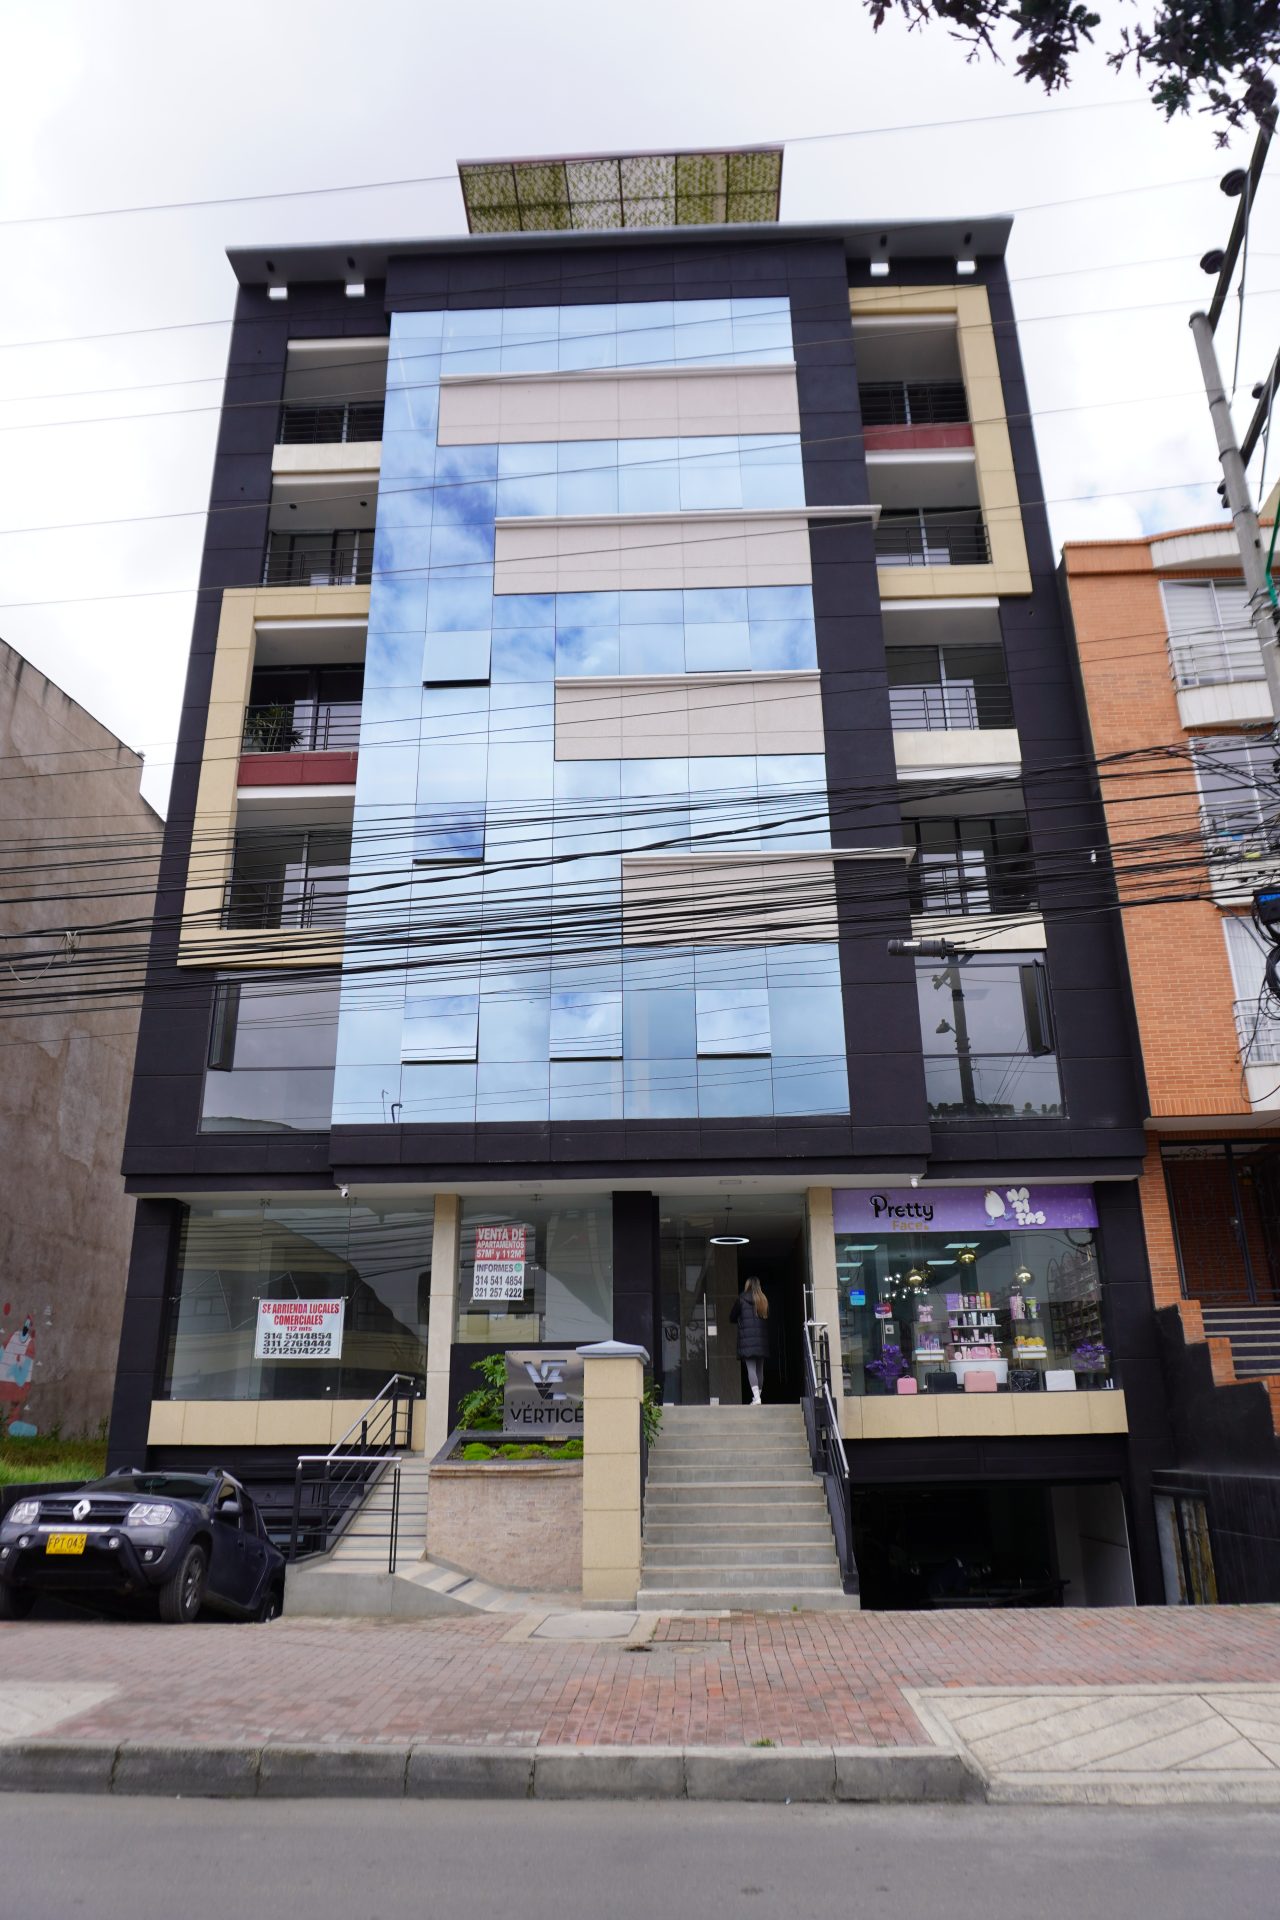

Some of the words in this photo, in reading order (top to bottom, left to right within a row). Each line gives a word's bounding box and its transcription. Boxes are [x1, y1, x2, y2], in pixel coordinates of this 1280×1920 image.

[869, 1194, 934, 1221] Pretty
[892, 1220, 923, 1231] Face
[478, 1228, 509, 1240] VENTA
[511, 1228, 525, 1240] DE
[477, 1240, 525, 1248] APARTAMENTOS
[476, 1264, 514, 1272] INFORMES
[475, 1275, 489, 1285] 314
[490, 1275, 503, 1285] 541
[505, 1275, 522, 1285] 4854
[474, 1287, 487, 1297] 321
[489, 1287, 503, 1297] 257
[504, 1287, 522, 1297] 4222
[262, 1303, 272, 1314] SE
[272, 1303, 308, 1314] ARRIENDA
[273, 1315, 324, 1325] COMERCIALES
[510, 1404, 584, 1424] VÉRTICE
